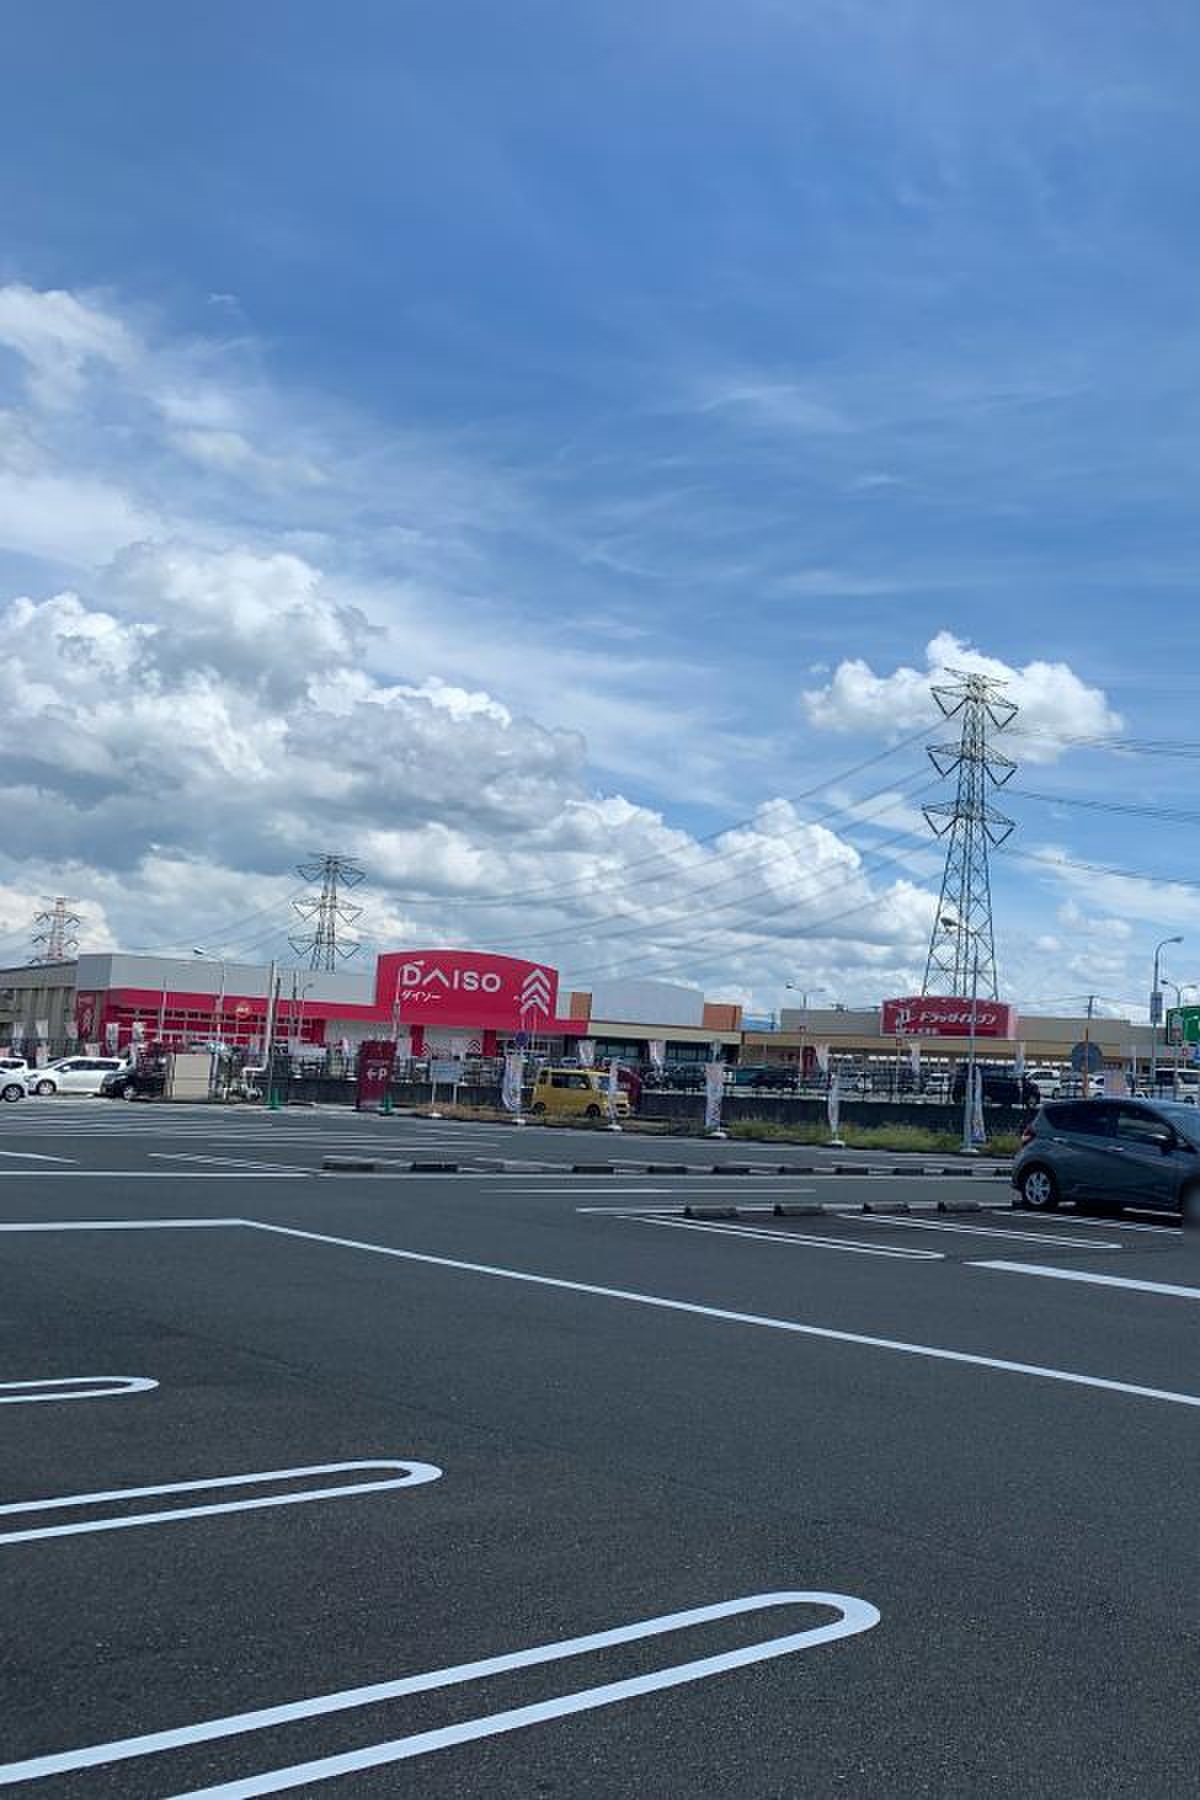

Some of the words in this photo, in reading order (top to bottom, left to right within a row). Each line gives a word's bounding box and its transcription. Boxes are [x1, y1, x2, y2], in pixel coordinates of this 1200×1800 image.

[402, 963, 501, 993] DAISO
[401, 991, 441, 1001] ダイソー
